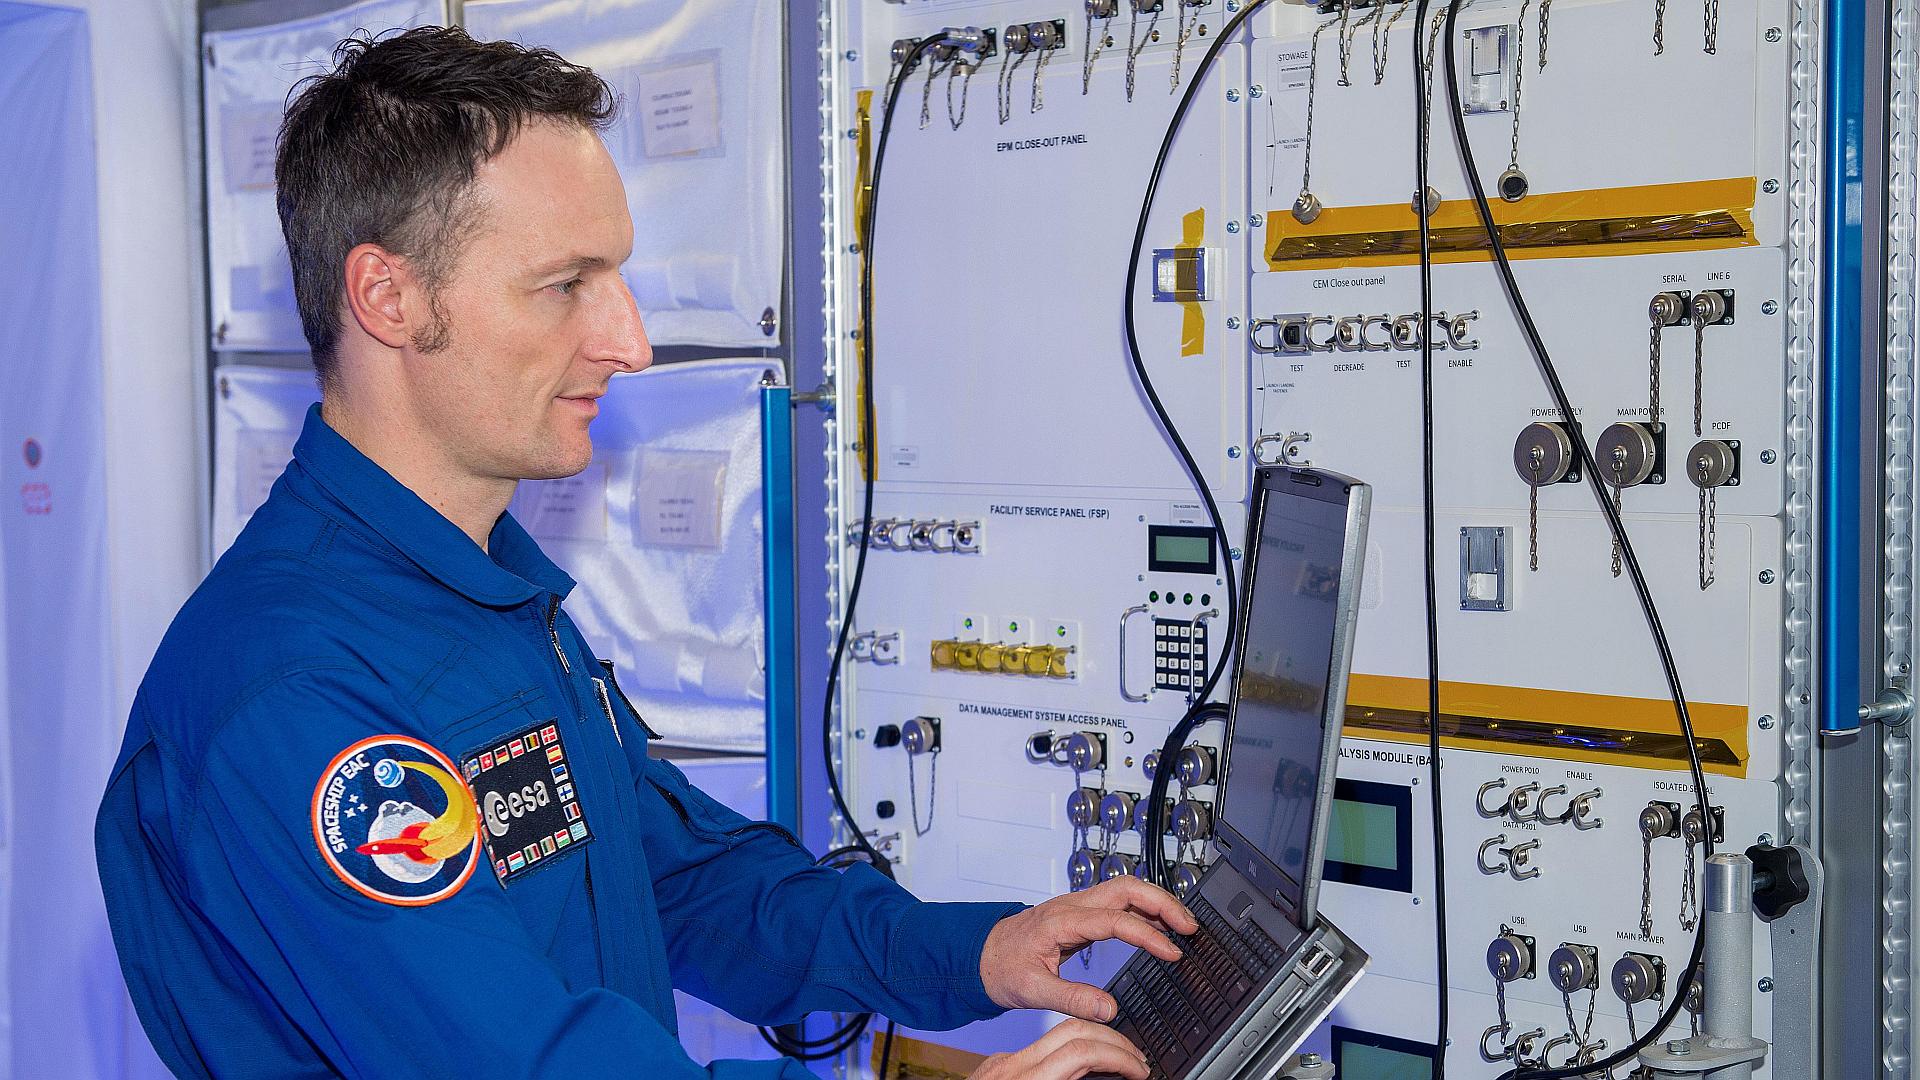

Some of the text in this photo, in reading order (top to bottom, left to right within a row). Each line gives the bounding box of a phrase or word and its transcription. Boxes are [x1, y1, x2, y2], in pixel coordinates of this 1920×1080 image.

[1278, 51, 1309, 61] STOWAGE
[997, 134, 1088, 152] EPM CLOSE-OUT PANEL
[1662, 274, 1687, 283] SERIAL
[1707, 271, 1731, 281] LINE 6
[1312, 275, 1386, 289] CEM Close out panel
[1290, 364, 1304, 372] TEST
[1333, 363, 1365, 372] DECREADE
[1396, 360, 1411, 368] TEST
[1448, 359, 1473, 368] ENABLE
[1531, 408, 1557, 417] POWER
[1617, 408, 1665, 416] MAIN POR
[1712, 422, 1731, 430] PCDF
[990, 505, 1110, 519] FACILITY SERVICE PANEL (FSP)
[959, 703, 1128, 728] DATA MANAGEMENT SYSTEM ACCESS PANEL
[1372, 750, 1414, 764] MODULE
[1415, 754, 1445, 769] (BA)
[1501, 765, 1524, 774] POWER
[1566, 770, 1593, 780] ENABLE
[1653, 781, 1714, 795] ISOLATED SEAL
[324, 753, 371, 854] SPACESHIP EAC
[507, 780, 551, 818] esa
[1502, 820, 1537, 831] DATA P201
[1511, 916, 1525, 925] USB
[1573, 924, 1587, 934] USB
[1616, 931, 1636, 941] MAIN
